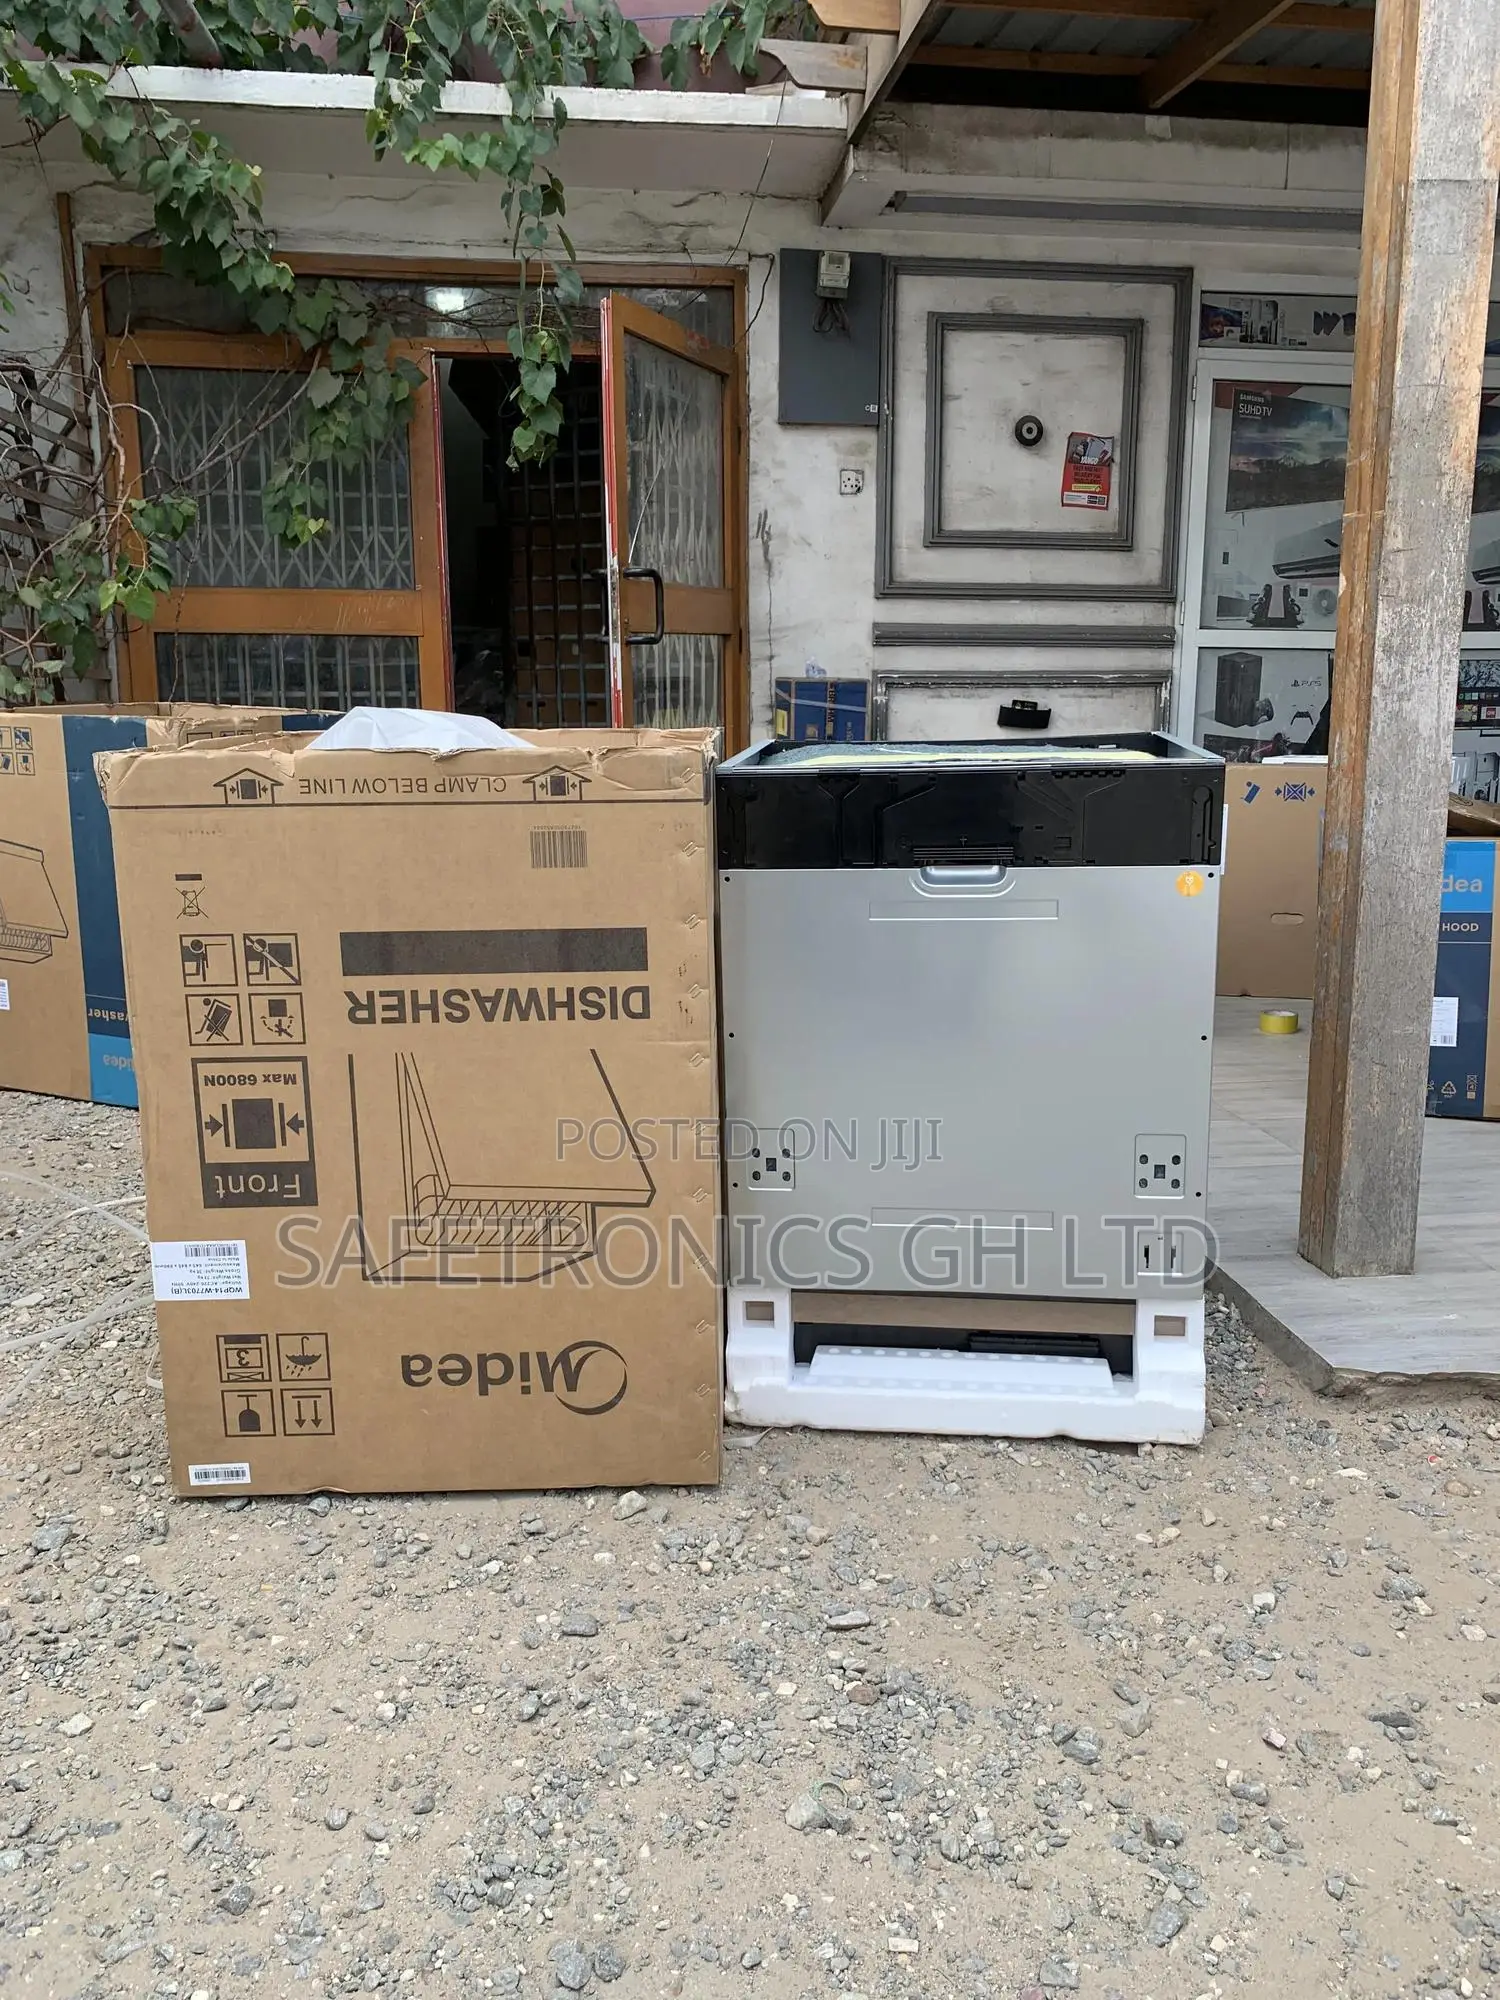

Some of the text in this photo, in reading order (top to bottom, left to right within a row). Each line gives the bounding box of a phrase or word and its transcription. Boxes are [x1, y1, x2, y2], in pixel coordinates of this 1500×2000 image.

[828, 689, 836, 723] BRHM
[299, 777, 507, 795] CLAMP BELOW LINE
[1440, 874, 1482, 893] dea
[1442, 922, 1479, 932] HOOD
[343, 985, 651, 1025] DISHWASHER
[88, 1008, 128, 1022] asher
[204, 1073, 297, 1087] Max 6800N
[215, 1173, 301, 1199] Front
[171, 1287, 243, 1295] WQP14-W7703L(B)
[236, 1349, 250, 1367] 3
[401, 1345, 612, 1402] Midea
